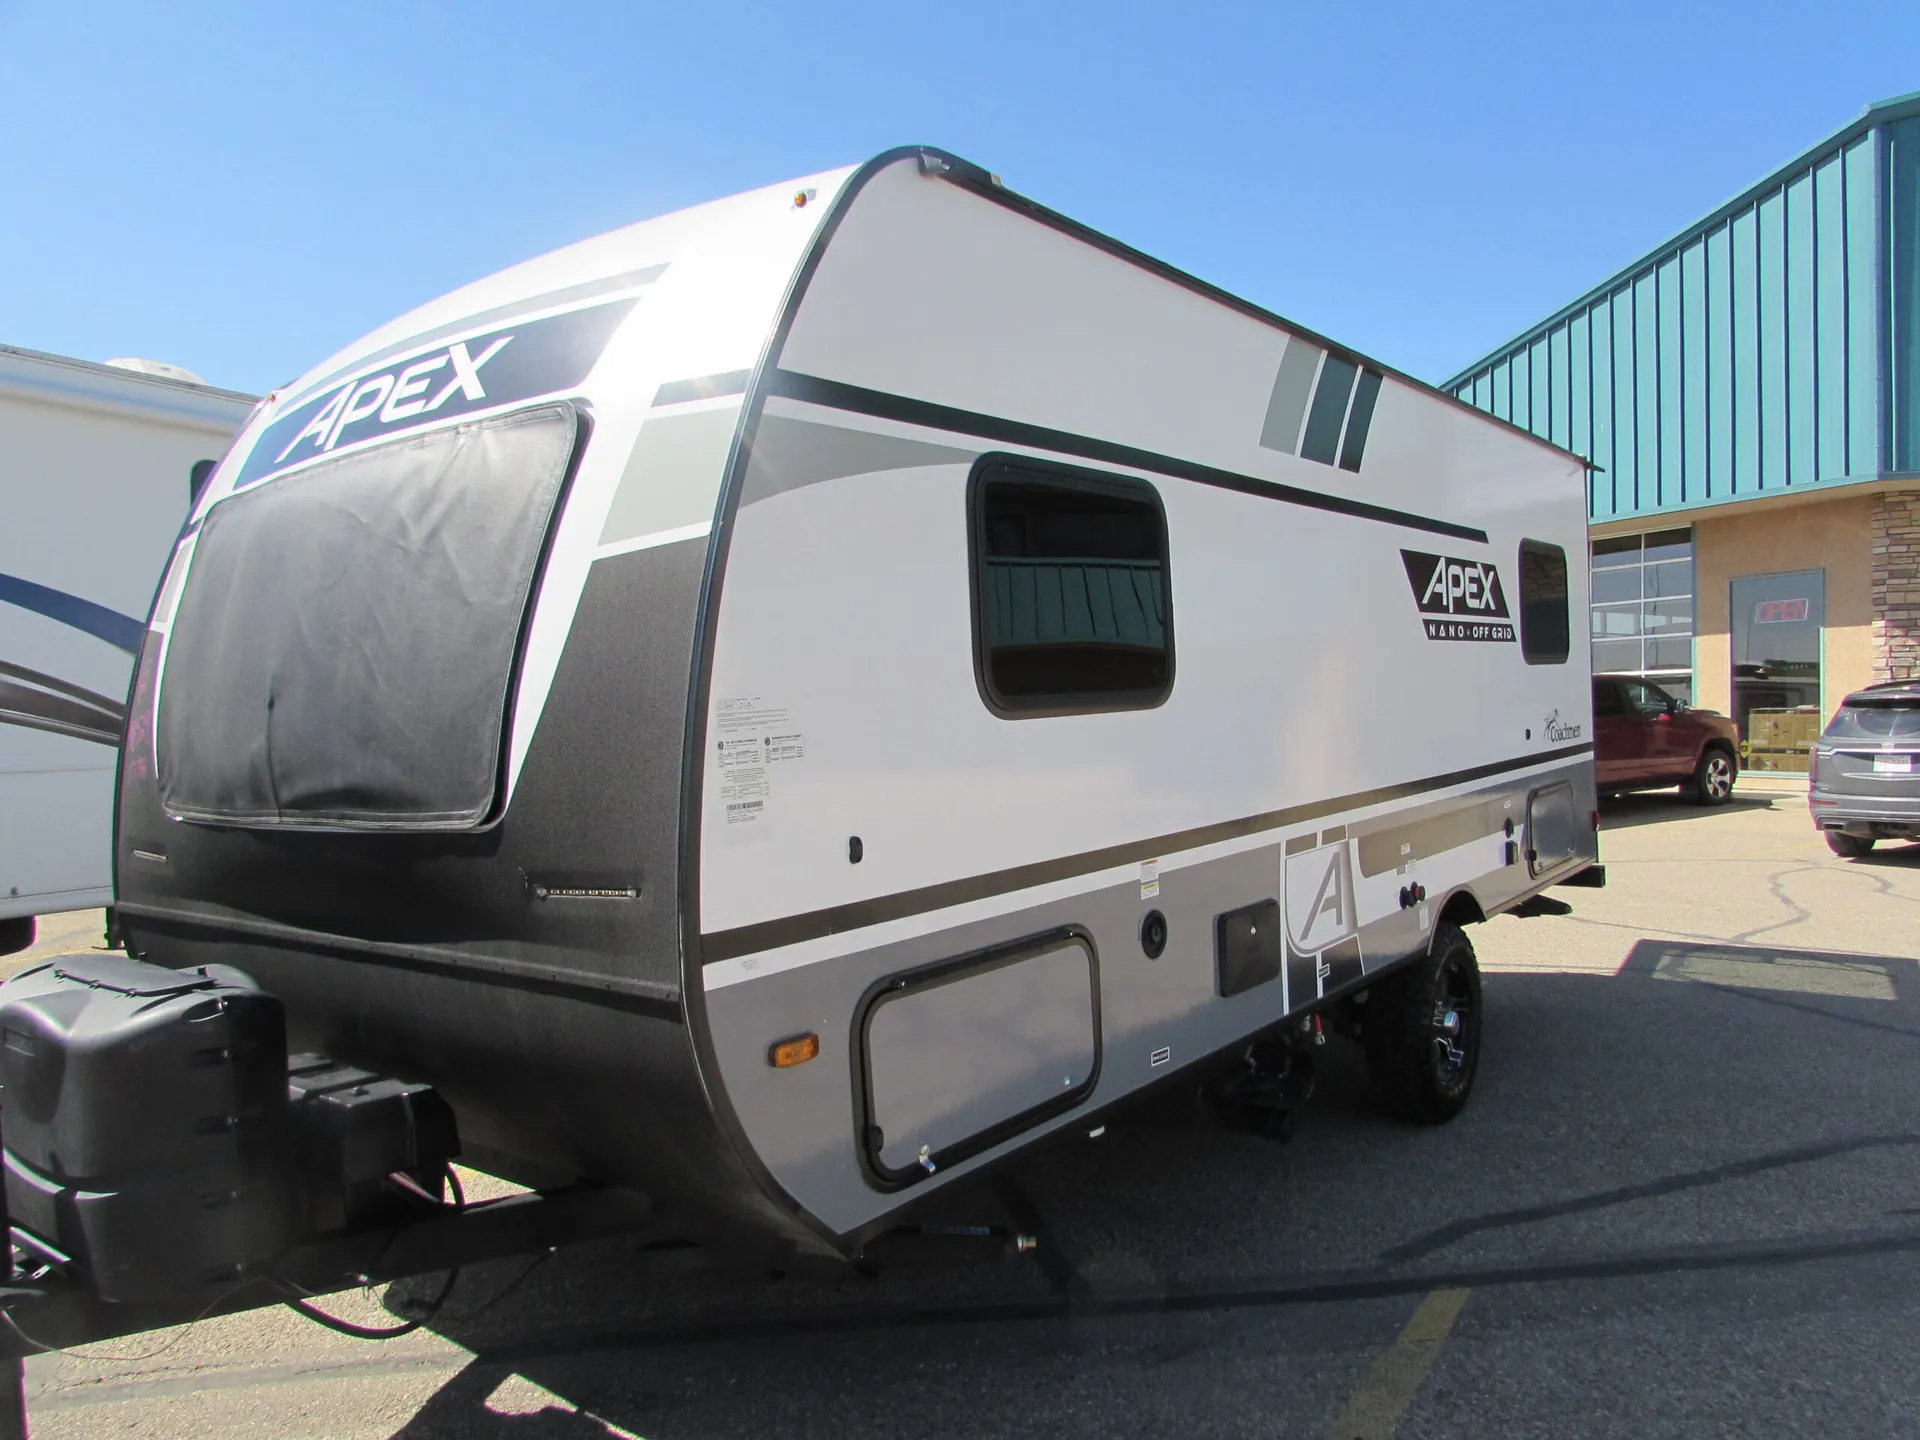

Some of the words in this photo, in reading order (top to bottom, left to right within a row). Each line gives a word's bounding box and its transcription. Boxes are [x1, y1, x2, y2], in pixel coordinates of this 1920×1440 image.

[275, 336, 514, 464] APEX
[1421, 556, 1496, 613] APEX
[1757, 600, 1806, 621] OPEN
[1429, 623, 1464, 638] NANO
[1472, 625, 1489, 639] OFF
[1491, 626, 1512, 640] GRID
[1550, 722, 1581, 743] Coachmen
